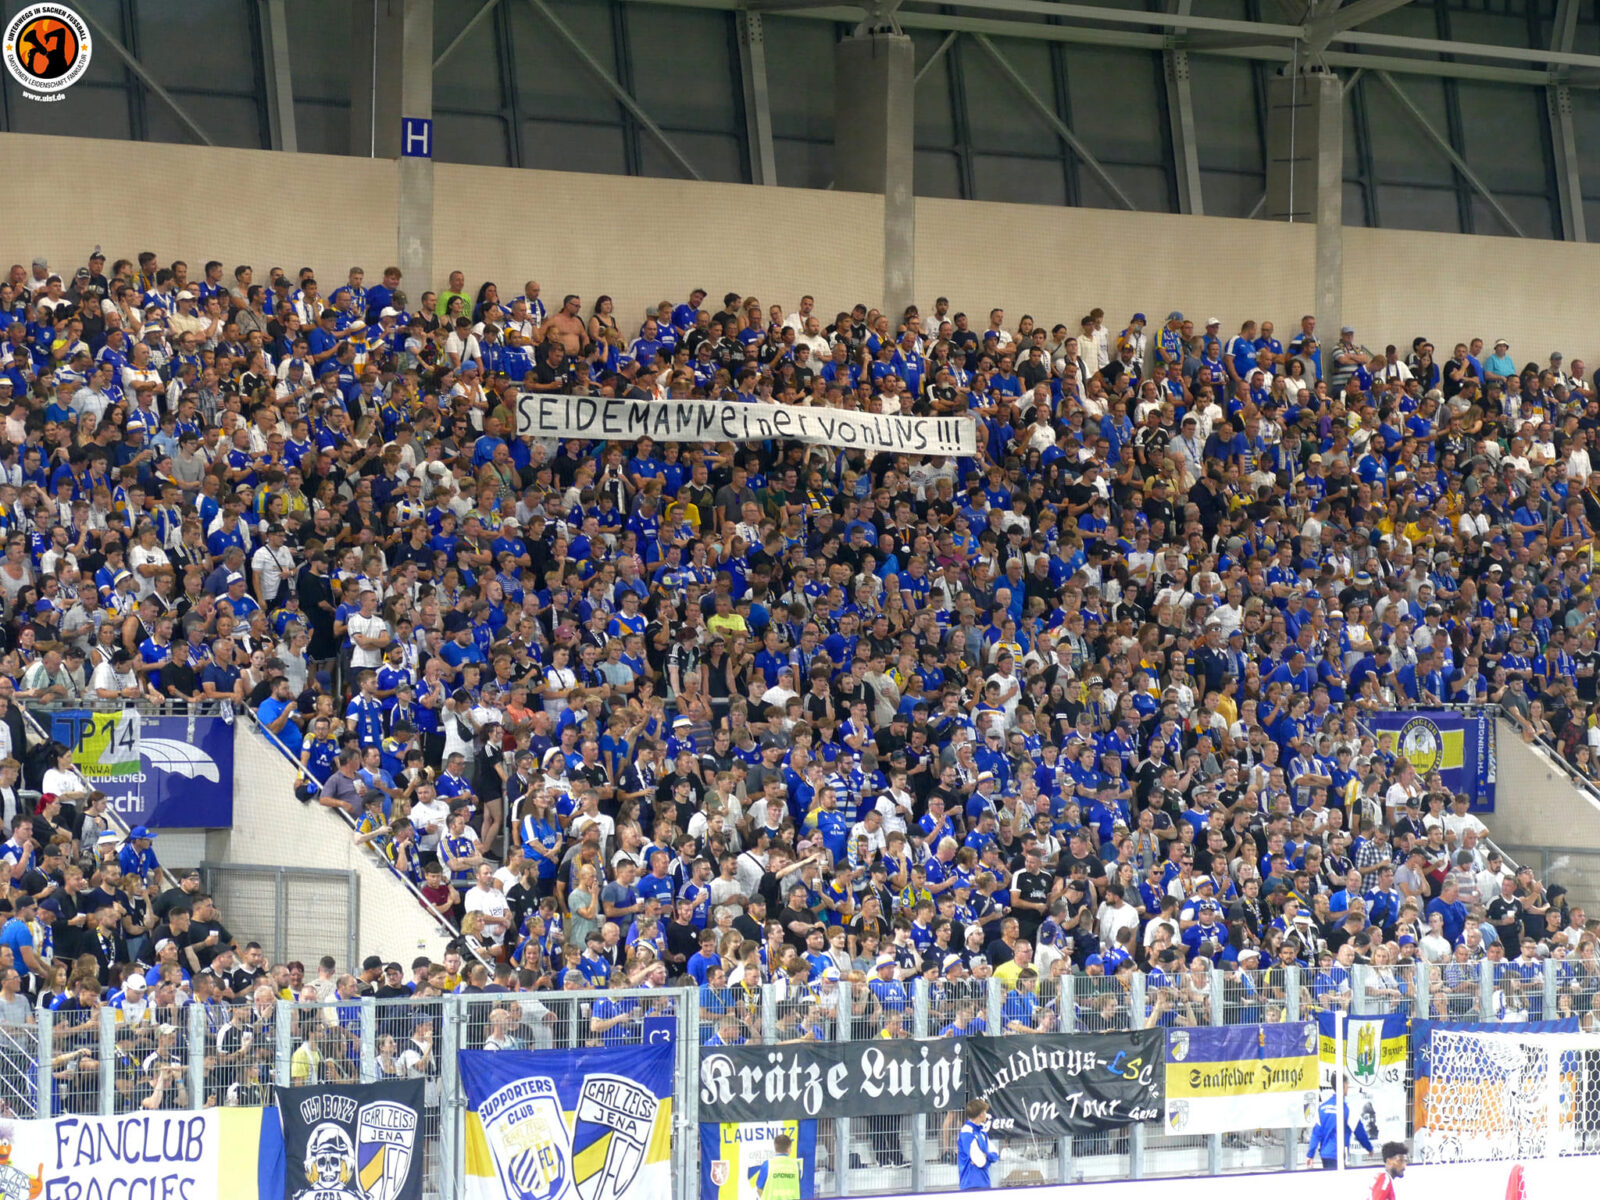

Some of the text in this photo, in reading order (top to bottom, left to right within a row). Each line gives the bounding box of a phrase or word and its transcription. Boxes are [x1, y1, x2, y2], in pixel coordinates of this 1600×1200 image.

[407, 121, 428, 154] H
[518, 396, 716, 437] SEIDEMANN
[721, 405, 807, 439] einer
[82, 765, 110, 775] YNWA
[700, 1043, 963, 1115] Krätze Luigi
[1189, 1065, 1304, 1092] Saalfelder Jungs
[300, 1094, 358, 1125] OLD BOYZ
[480, 1080, 552, 1121] SUPPORTERS
[588, 1083, 653, 1119] CARL ZEISS
[1066, 1093, 1122, 1118] Tour
[364, 1109, 413, 1128] CARL ZEISS
[507, 1104, 534, 1125] CLUB
[594, 1108, 638, 1136] JENA
[55, 1116, 206, 1170] FANCLUB
[371, 1129, 404, 1142] JENA
[723, 1127, 796, 1144] LAUSNITZ
[538, 1146, 554, 1169] FC
